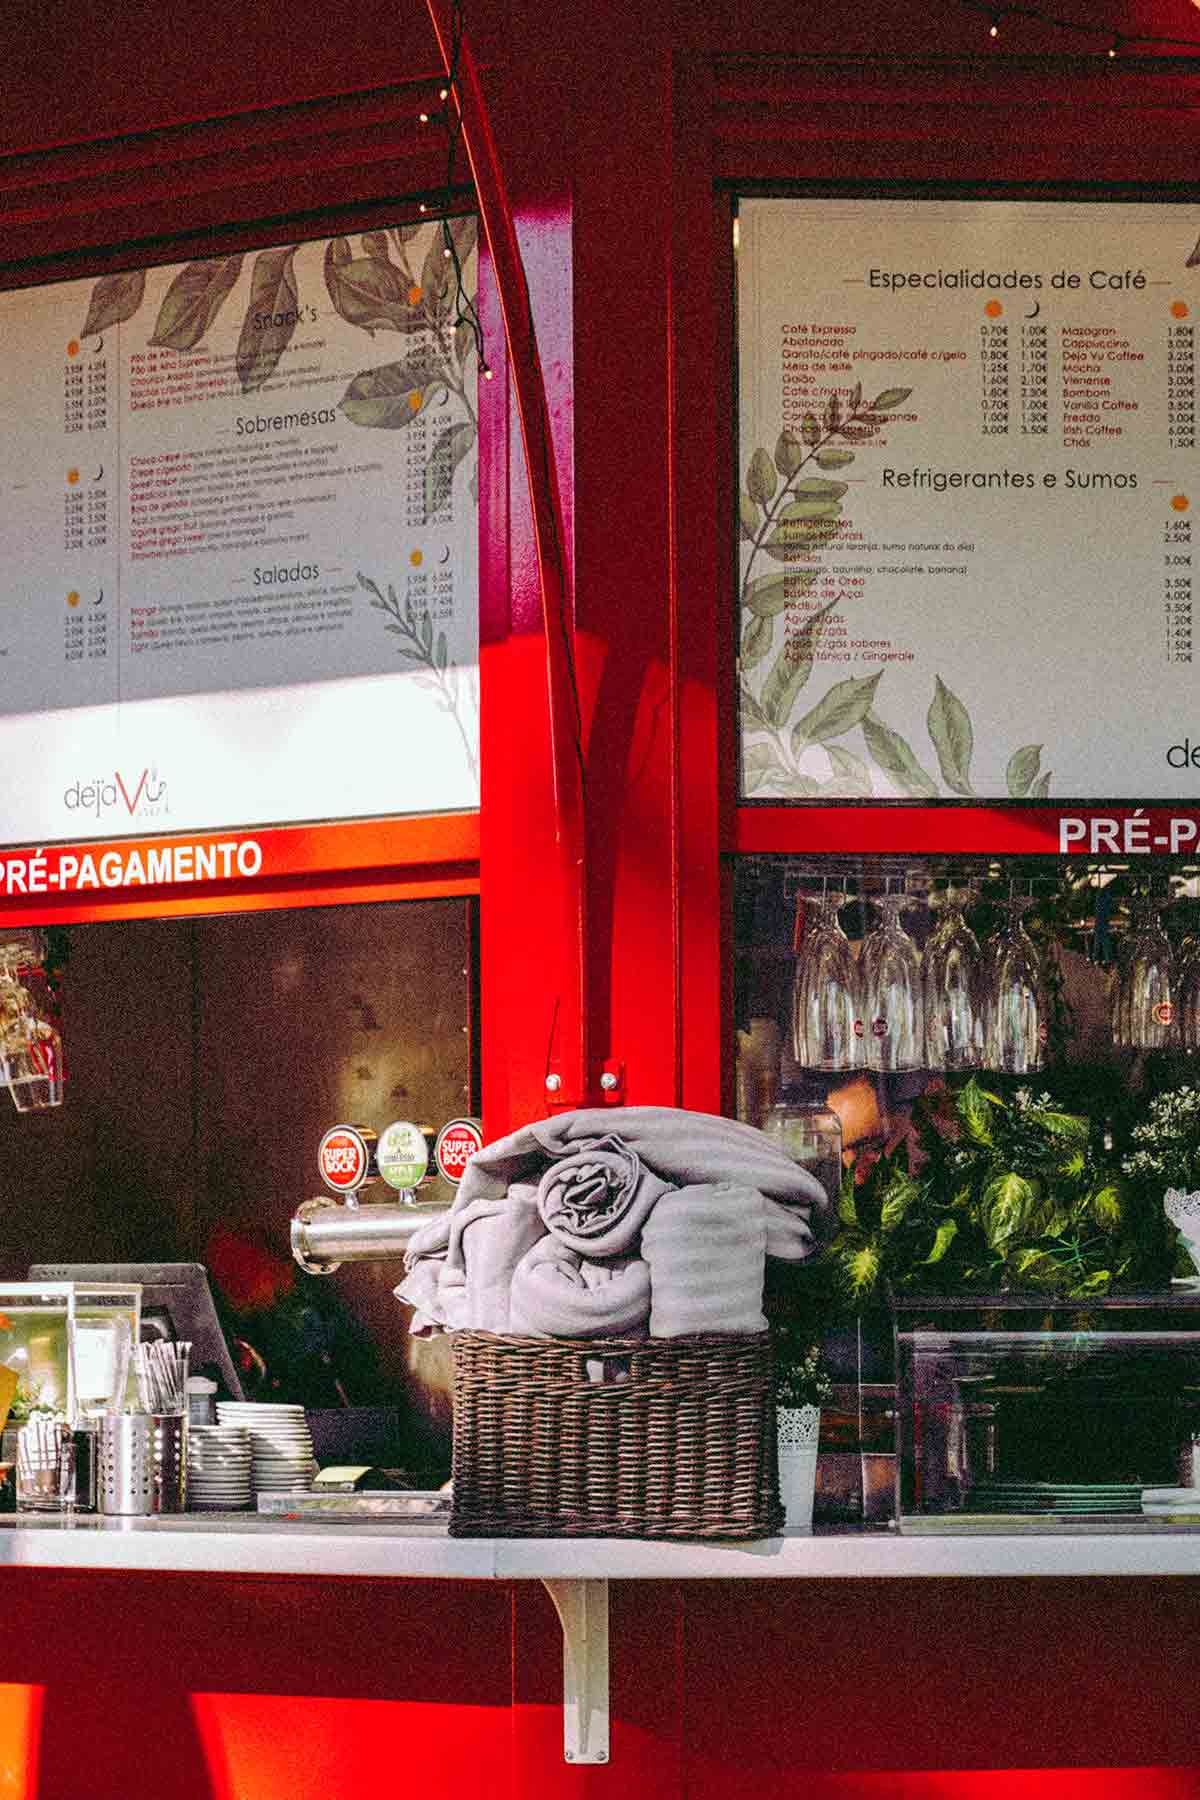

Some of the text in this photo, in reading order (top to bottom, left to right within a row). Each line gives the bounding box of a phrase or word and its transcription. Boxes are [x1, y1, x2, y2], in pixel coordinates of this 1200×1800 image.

[869, 269, 1147, 293] Especialidades de Café
[254, 304, 317, 330] Snack's
[782, 324, 857, 336] Café Expresso
[981, 326, 1047, 336] 0.70€ 1.00€
[1062, 327, 1116, 338] Mazagran
[782, 337, 844, 347] Abatanado
[1062, 339, 1130, 350] Cappuccino
[782, 349, 849, 360] Garoto/café
[852, 349, 928, 361] pingado/café
[981, 351, 1047, 360] 0.80€ 1.10€
[1107, 351, 1144, 361] Coffee
[782, 362, 853, 372] Meia de leite
[1062, 364, 1100, 373] Mocha
[782, 374, 816, 385] Galão
[1062, 376, 1112, 386] Vienense
[782, 387, 809, 397] Café
[1062, 388, 1110, 398] Bombom
[981, 400, 1008, 410] 0.70€
[1063, 401, 1138, 411] Vanilla Coffee
[236, 407, 336, 436] Sobremesas
[1063, 413, 1101, 423] Freddo
[1063, 425, 1123, 435] Irish Coffee
[1168, 438, 1194, 448] 1.50€
[882, 468, 1138, 491] Refrigerantes e Sumos
[253, 562, 320, 587] Saladas
[822, 576, 836, 586] de
[838, 576, 865, 586] Oreo
[820, 589, 835, 599] de
[850, 639, 891, 649] sabores
[862, 651, 914, 663] Gingerale
[1059, 809, 1200, 854] PRÉ-P
[442, 1139, 476, 1153] SUPER
[323, 1148, 357, 1161] SUPER
[443, 1153, 471, 1166] BOC
[325, 1160, 356, 1173] BOCK
